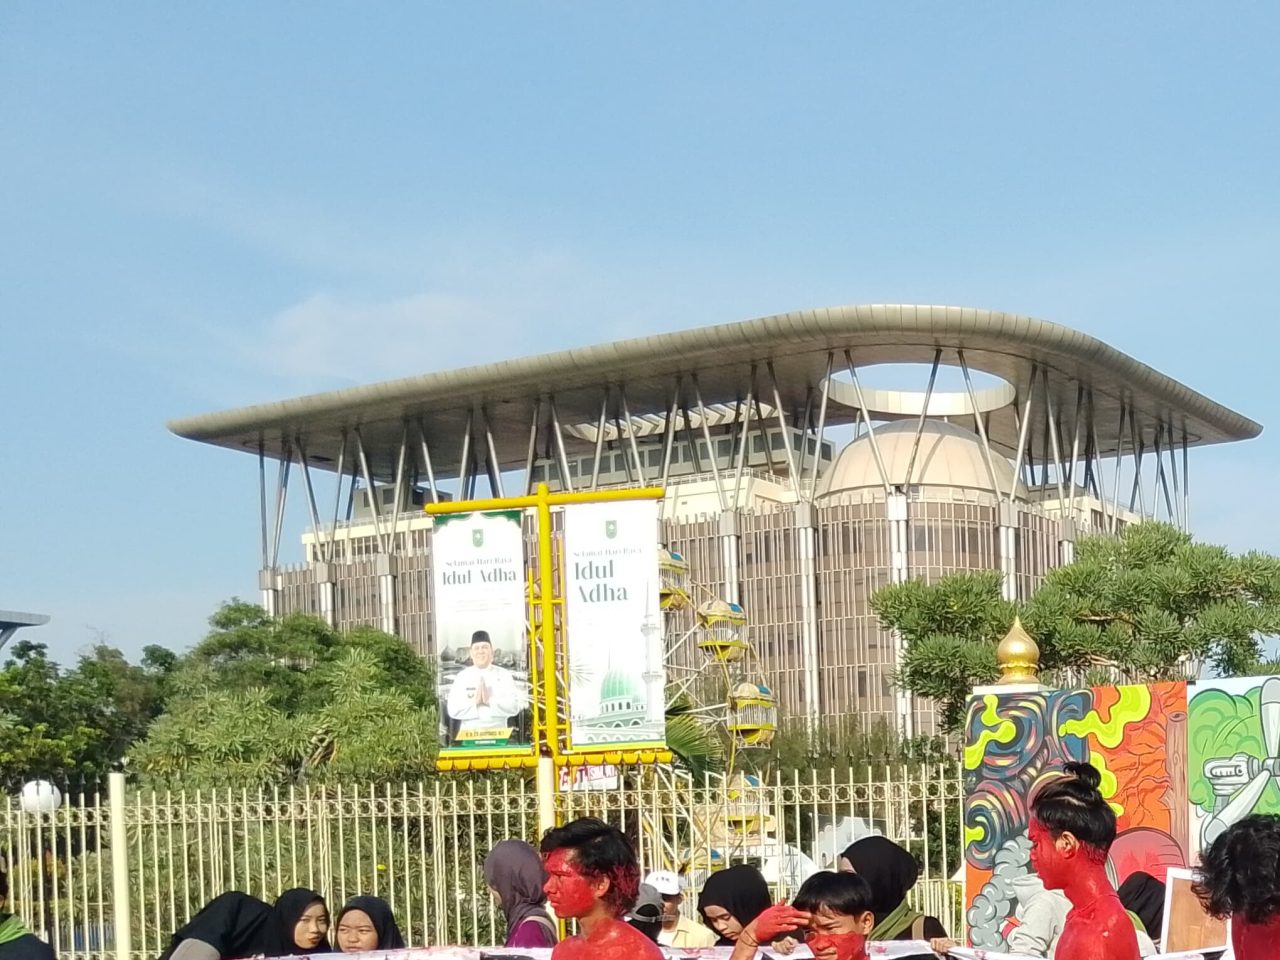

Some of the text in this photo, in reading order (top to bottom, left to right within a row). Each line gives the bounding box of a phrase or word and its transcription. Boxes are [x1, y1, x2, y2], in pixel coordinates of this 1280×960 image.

[443, 567, 517, 585] Idul Adha
[575, 559, 614, 580] Idul
[579, 583, 628, 603] Adha
